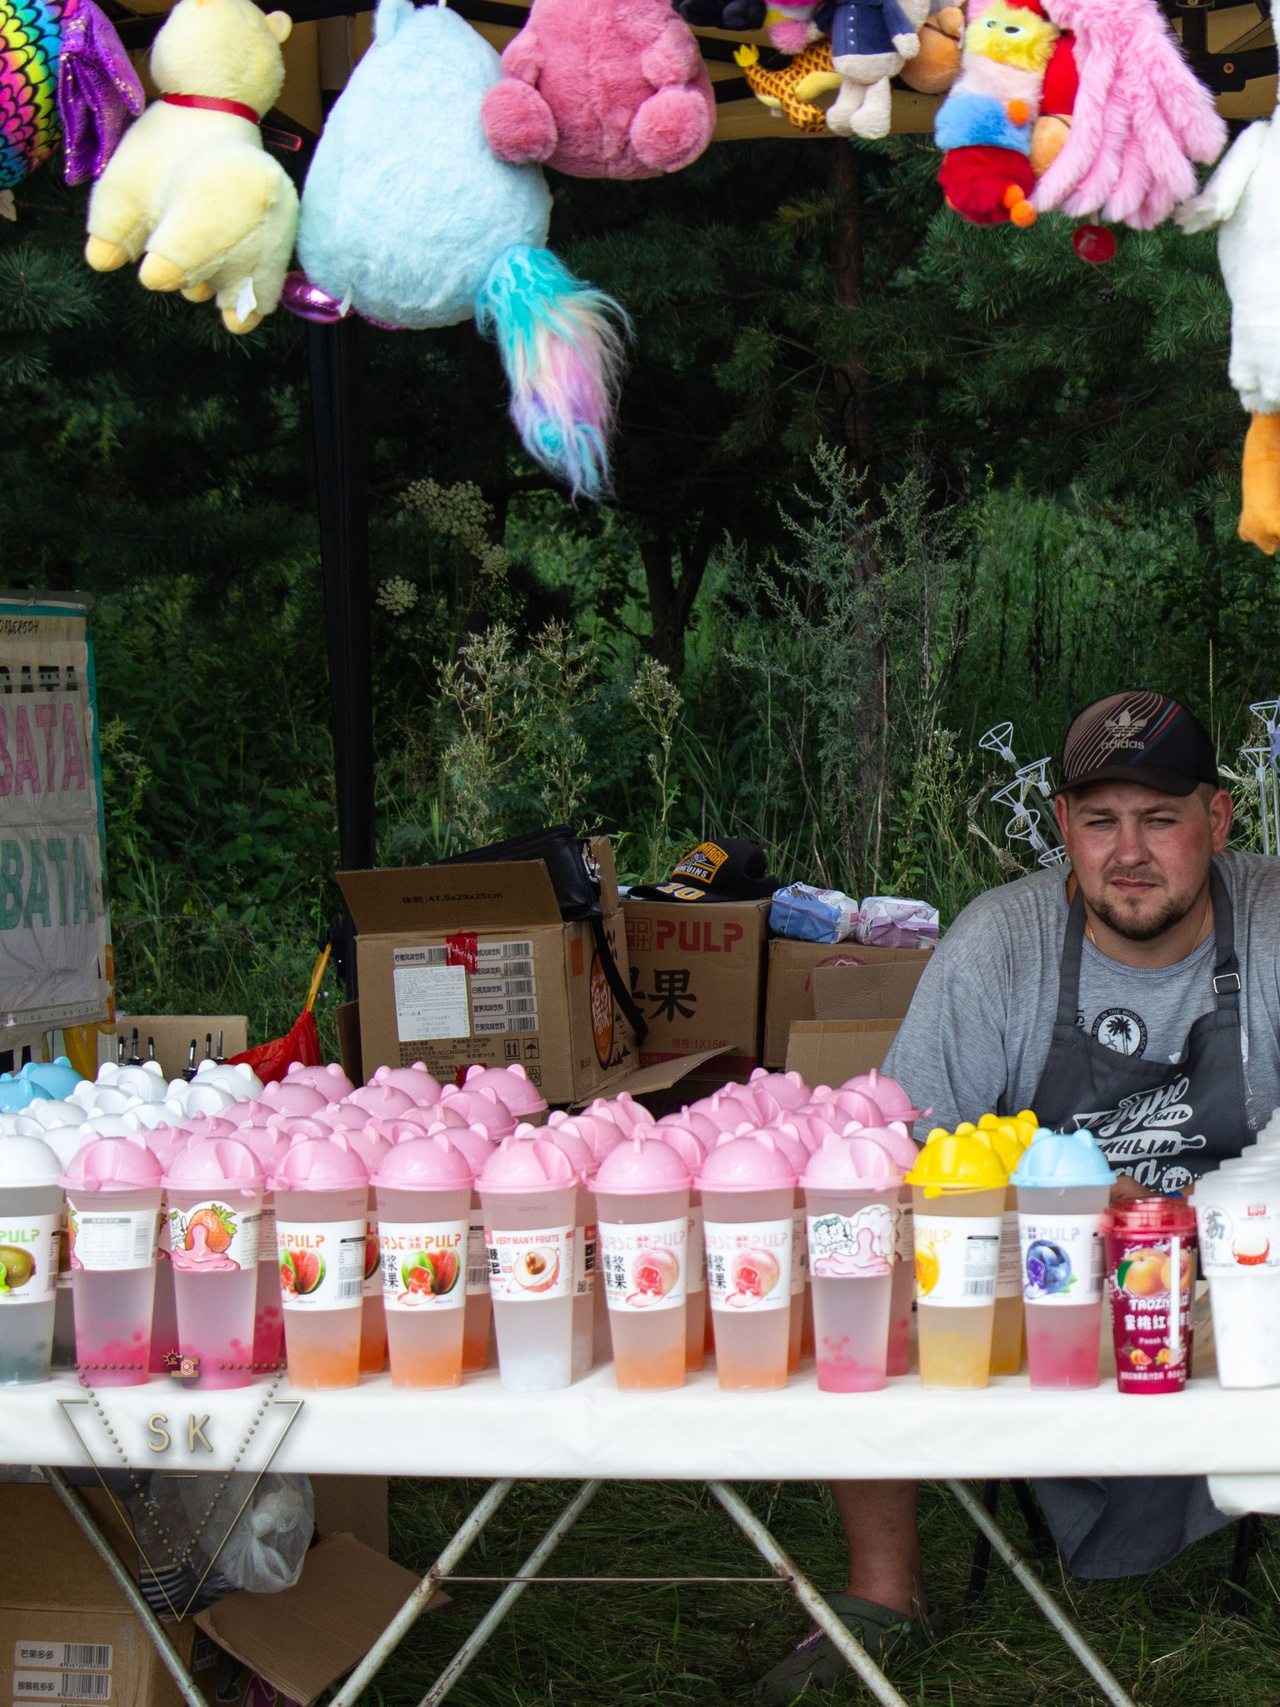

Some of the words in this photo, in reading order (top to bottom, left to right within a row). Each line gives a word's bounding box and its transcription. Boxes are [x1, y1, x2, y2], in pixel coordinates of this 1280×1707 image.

[1101, 737, 1145, 750] adidas
[656, 882, 706, 900] 10
[656, 919, 744, 953] PULP
[1122, 1009, 1143, 1026] WORLD
[1138, 1027, 1147, 1050] BLACK
[287, 1234, 325, 1248] PULP
[424, 1233, 462, 1249] PULP
[496, 1236, 511, 1245] VERY
[512, 1235, 534, 1244] MANY
[535, 1234, 560, 1243] FRUITS
[653, 1231, 686, 1247] PULP
[752, 1232, 789, 1248] PULP
[1039, 1227, 1080, 1241] PULP
